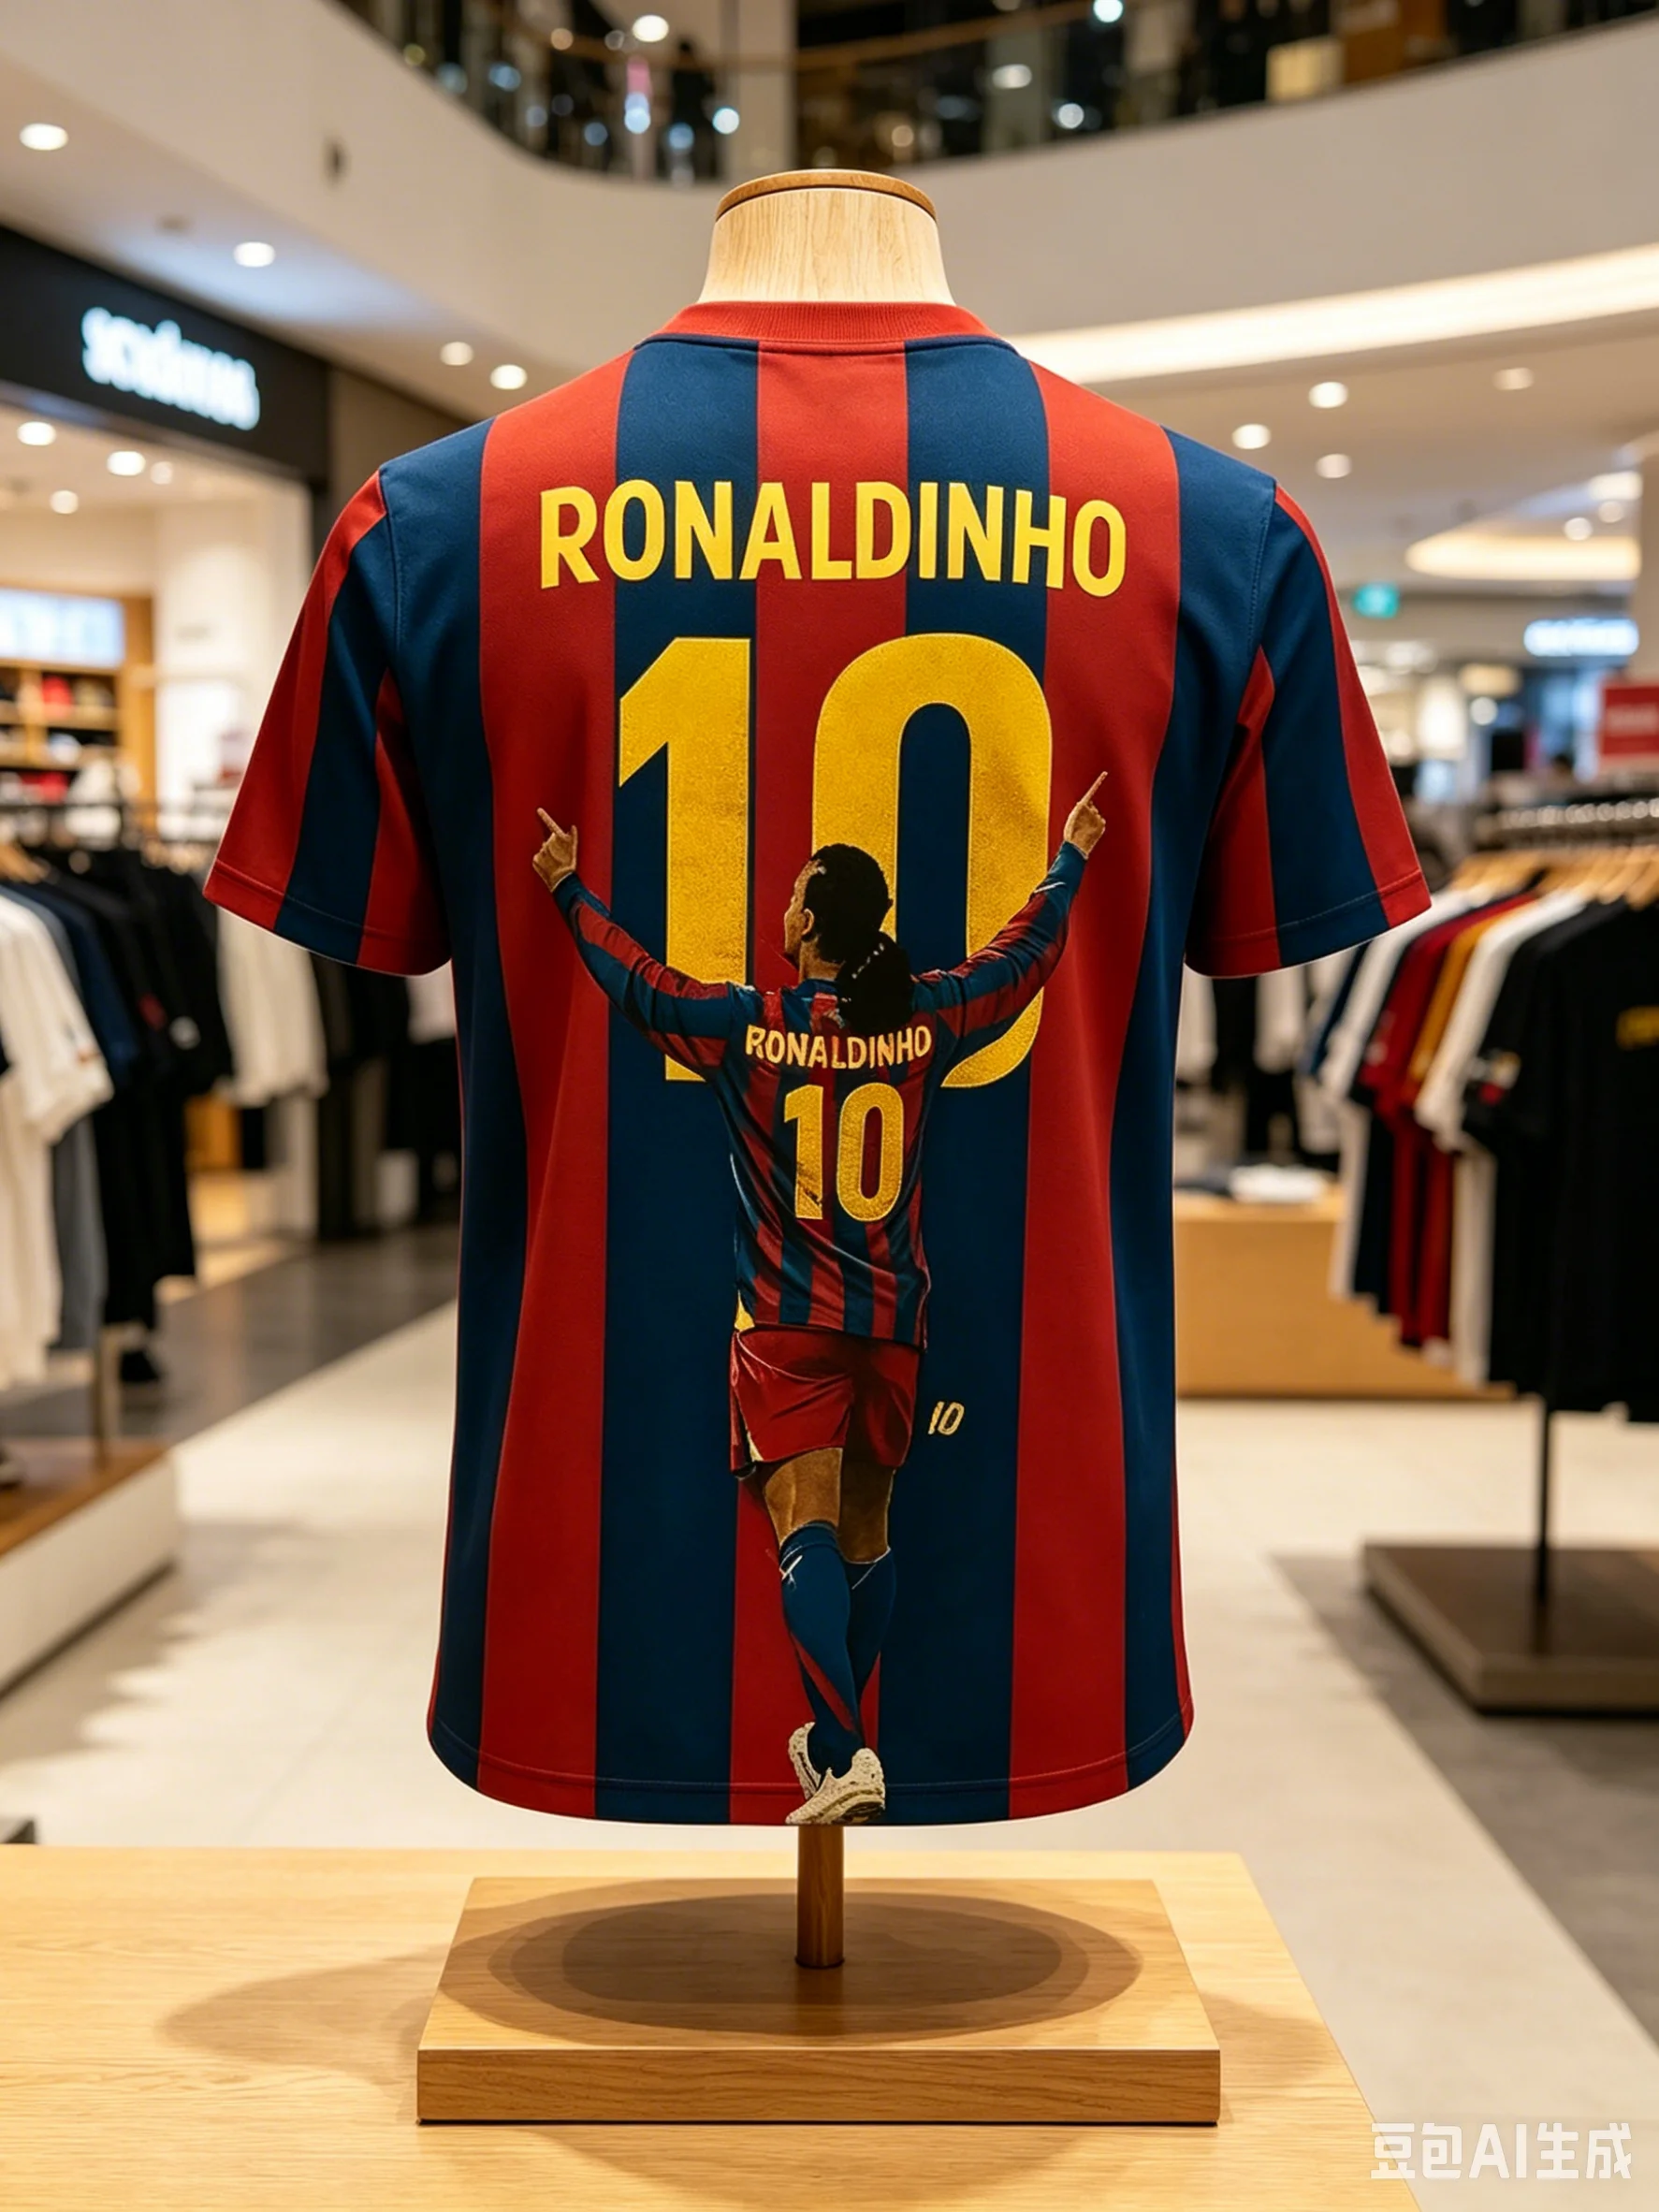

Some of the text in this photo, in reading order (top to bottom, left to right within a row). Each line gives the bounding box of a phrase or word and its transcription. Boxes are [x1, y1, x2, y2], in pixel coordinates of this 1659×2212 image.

[540, 479, 1127, 597] RONALDINHO
[618, 633, 1053, 1088] 10
[745, 1025, 932, 1070] RONALDINHO
[784, 1082, 904, 1222] 10
